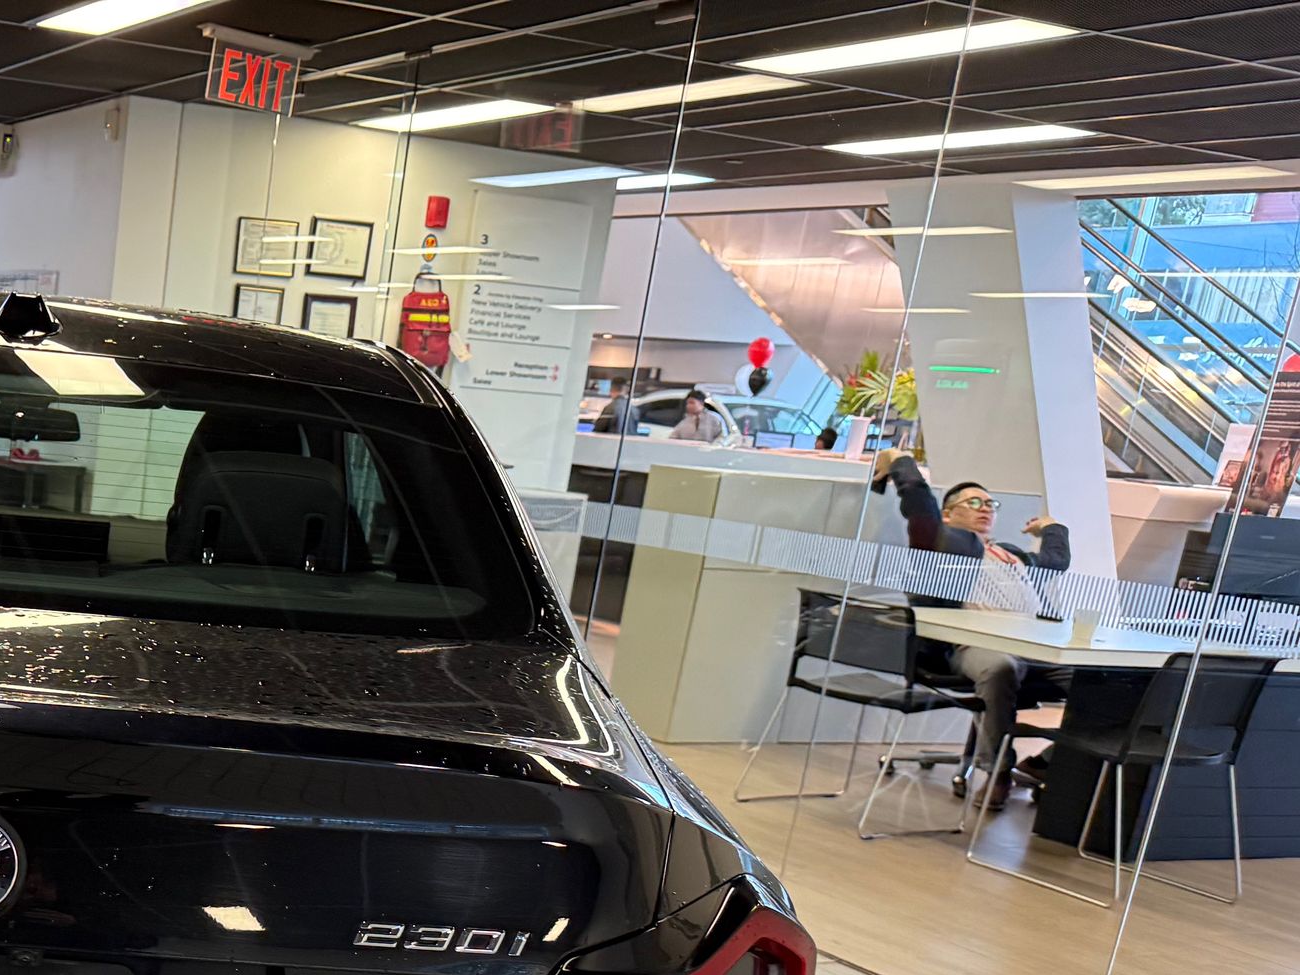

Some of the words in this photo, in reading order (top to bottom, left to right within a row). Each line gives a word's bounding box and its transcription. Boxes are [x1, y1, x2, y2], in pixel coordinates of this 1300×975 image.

[218, 48, 292, 112] EXIT
[481, 234, 489, 245] 3
[473, 284, 481, 295] 2
[502, 322, 526, 330] Lounge
[514, 332, 540, 342] Lounge
[353, 921, 532, 957] 230i
